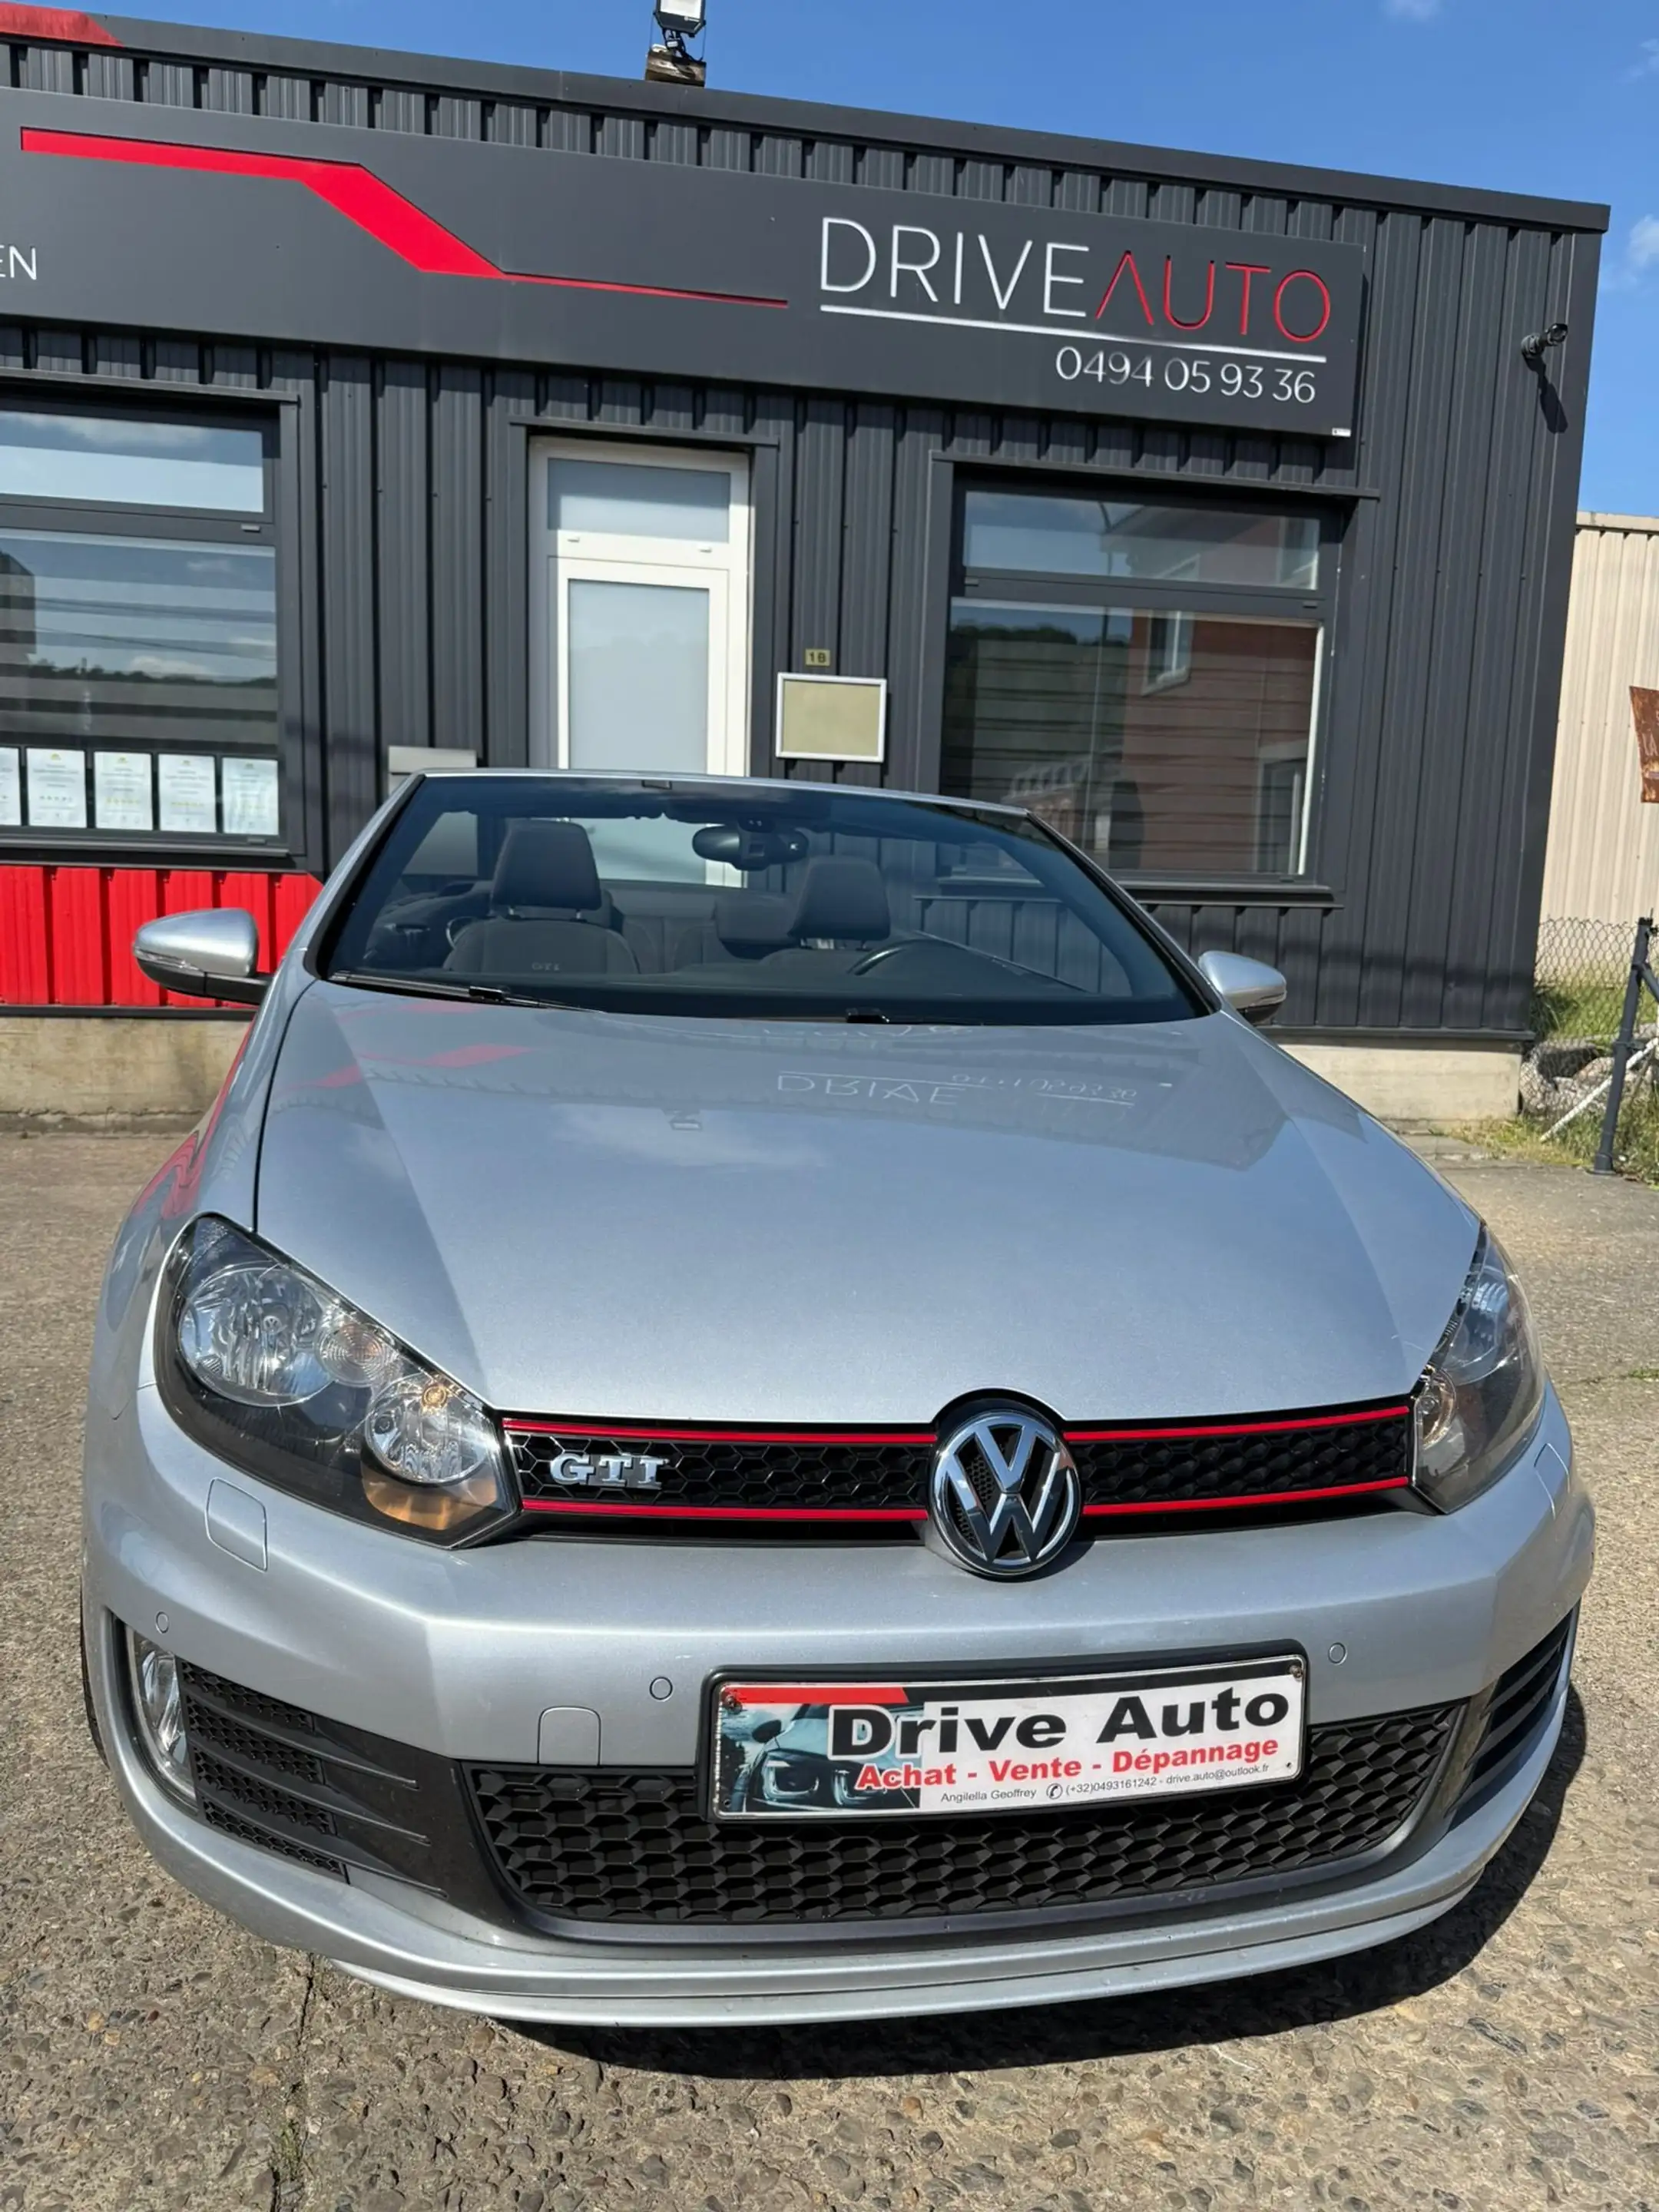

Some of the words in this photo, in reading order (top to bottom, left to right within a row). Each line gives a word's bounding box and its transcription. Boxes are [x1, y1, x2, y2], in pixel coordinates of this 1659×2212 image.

[1055, 346, 1154, 388] 0494
[1164, 357, 1211, 393] 05
[1220, 363, 1263, 399] 93
[1272, 368, 1316, 404] 36
[549, 1452, 670, 1490] GTI
[831, 1706, 1067, 1757] Drive
[1095, 1686, 1290, 1744] Auto
[856, 1763, 957, 1790] Achat
[988, 1757, 1082, 1782] Vente
[1112, 1738, 1279, 1774] Dépannage
[990, 1788, 1037, 1800] Geoffrey
